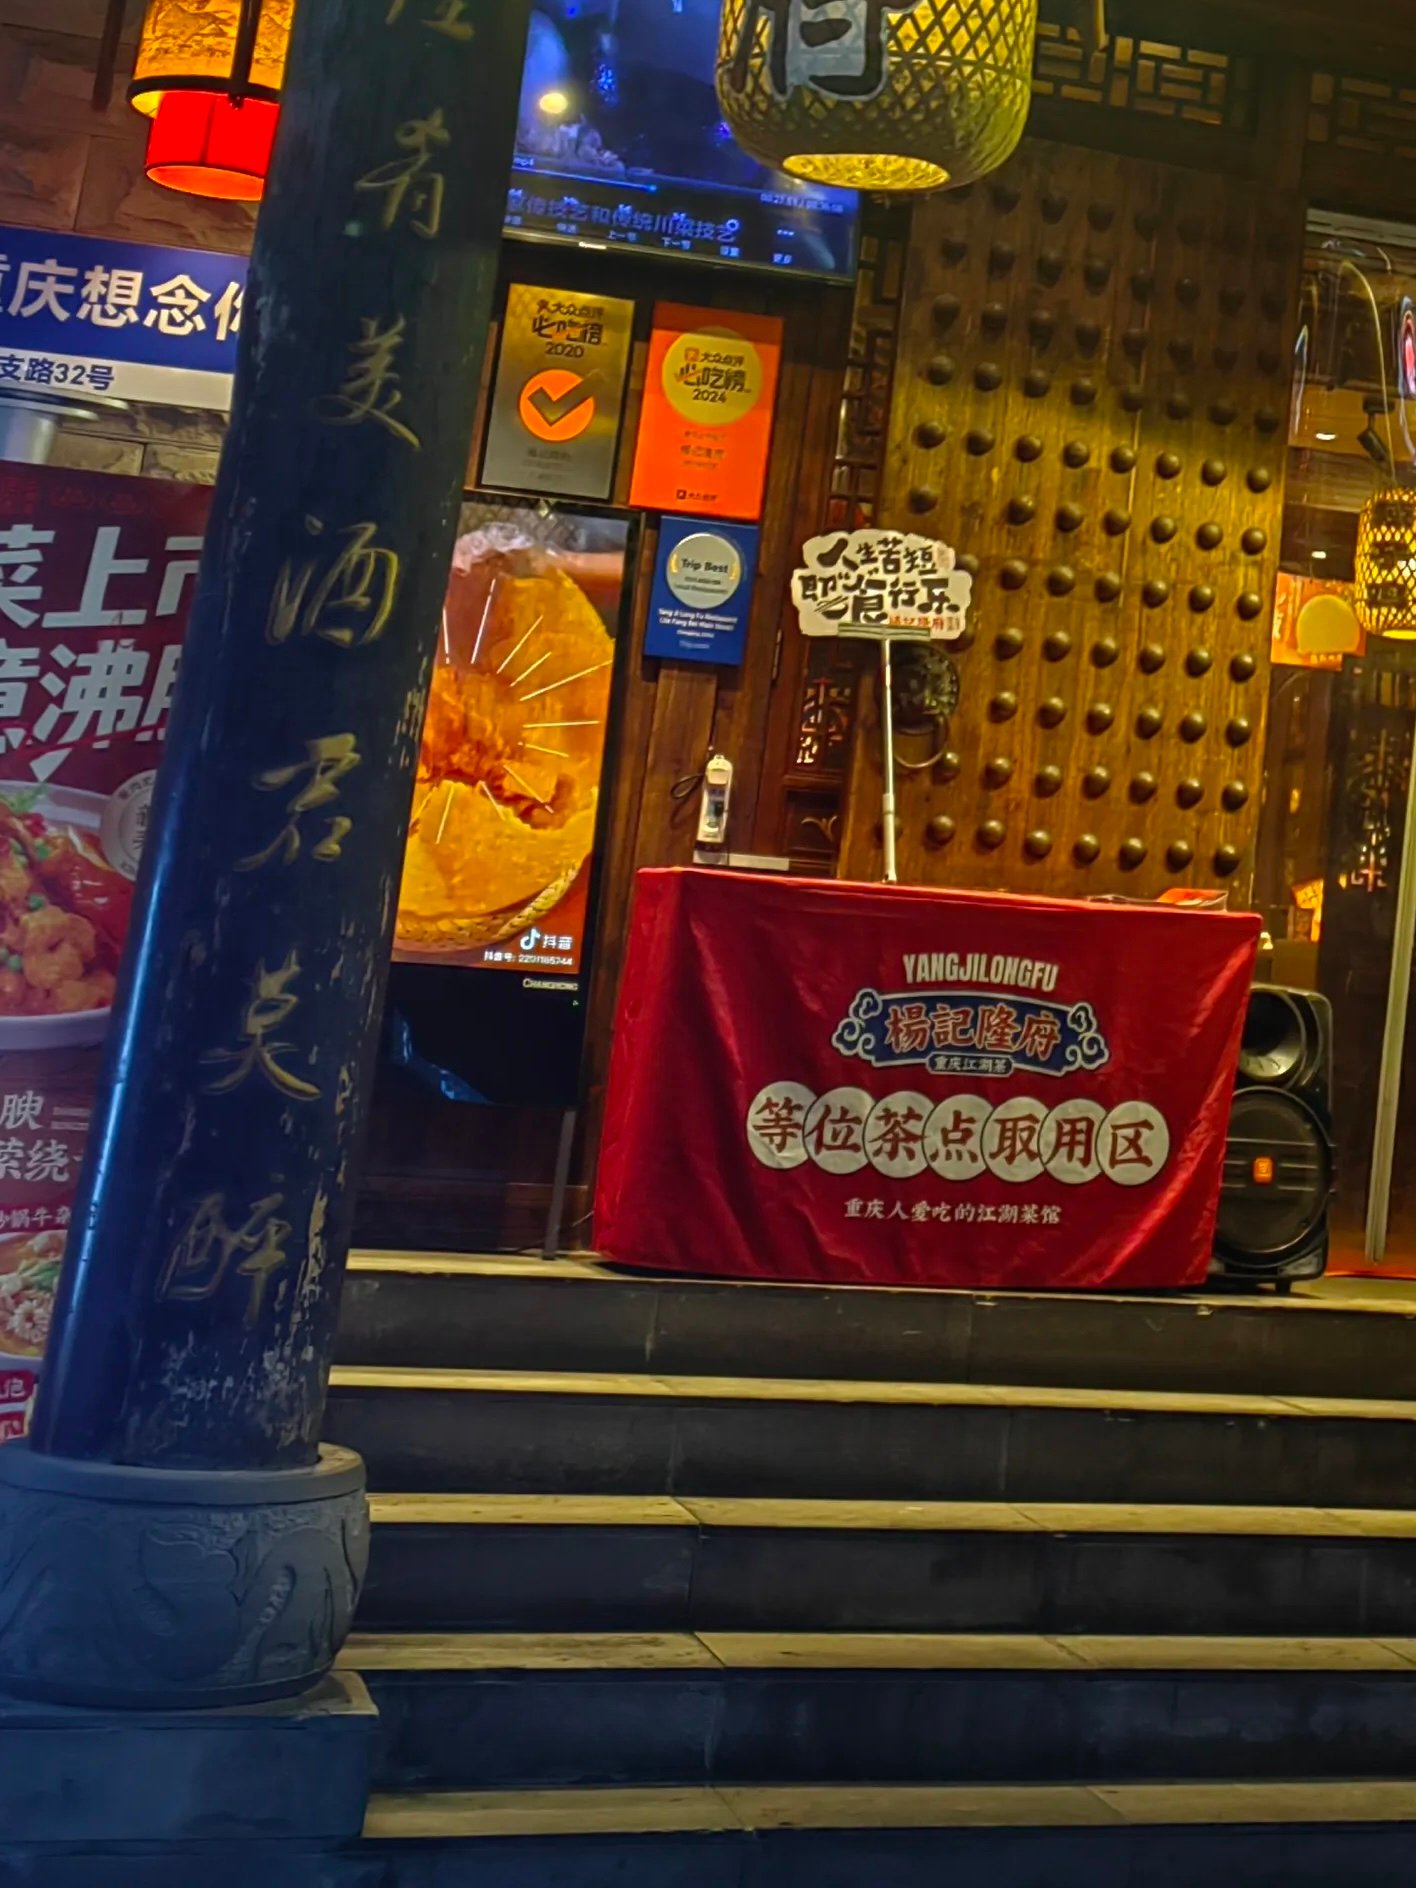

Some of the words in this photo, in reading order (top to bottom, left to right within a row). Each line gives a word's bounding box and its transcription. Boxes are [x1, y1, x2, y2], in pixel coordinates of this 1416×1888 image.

[545, 341, 585, 359] 2020
[692, 388, 727, 404] 2024
[816, 537, 938, 577] 人生苦短
[542, 934, 573, 951] 抖音
[902, 953, 1059, 992] YANGJILONGFU
[885, 1002, 1062, 1061] 楊記隆府
[933, 1056, 1007, 1074] 重庆江湖菜
[752, 1096, 1155, 1170] 等位茶点取用区
